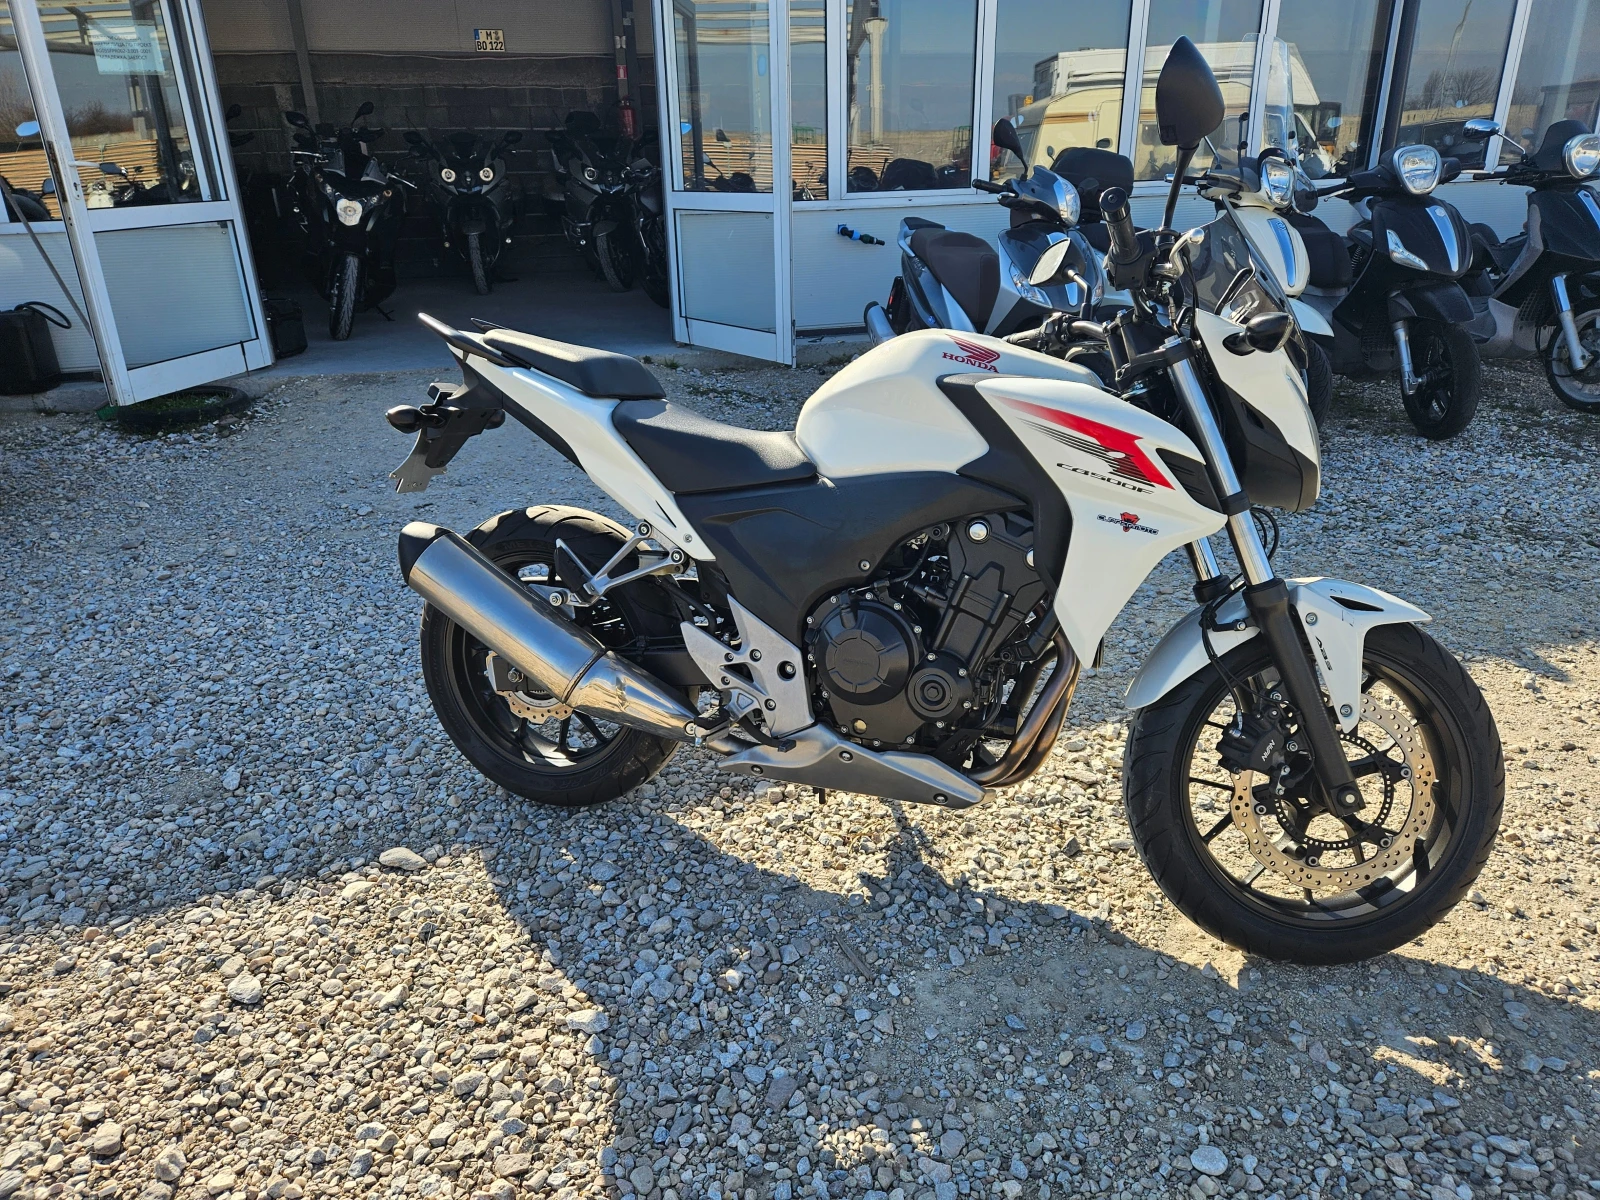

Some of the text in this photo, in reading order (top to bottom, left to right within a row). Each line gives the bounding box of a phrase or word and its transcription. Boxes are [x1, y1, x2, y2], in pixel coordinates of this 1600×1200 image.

[486, 31, 492, 40] M
[489, 41, 504, 50] 122
[942, 352, 999, 373] HONDA
